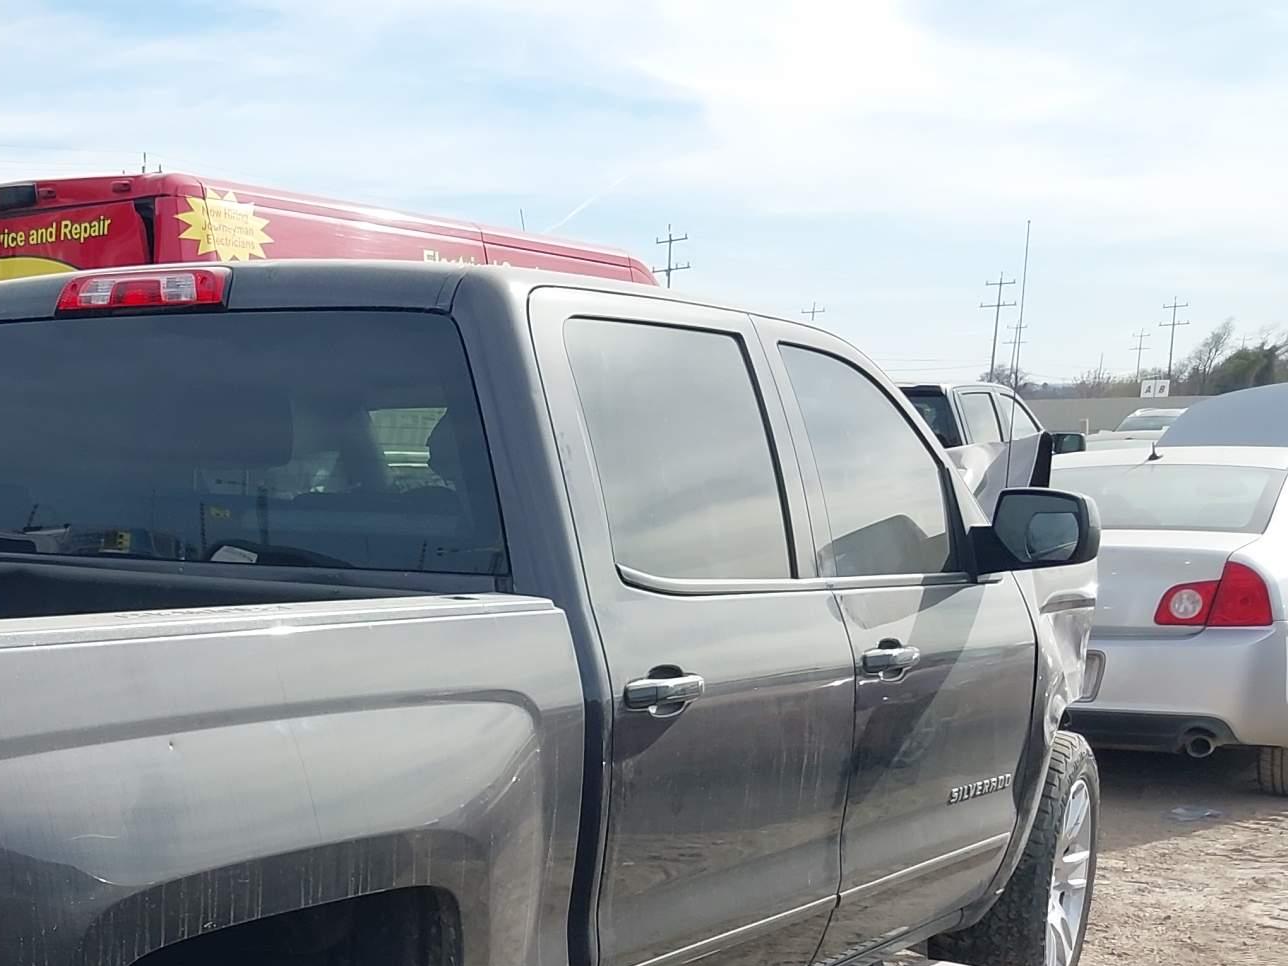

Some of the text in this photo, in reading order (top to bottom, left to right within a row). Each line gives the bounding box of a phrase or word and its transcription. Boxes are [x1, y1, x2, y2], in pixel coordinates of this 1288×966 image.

[29, 222, 57, 245] and
[61, 216, 111, 243] Repair
[1144, 384, 1152, 394] A
[950, 773, 1012, 804] SILVERADO
